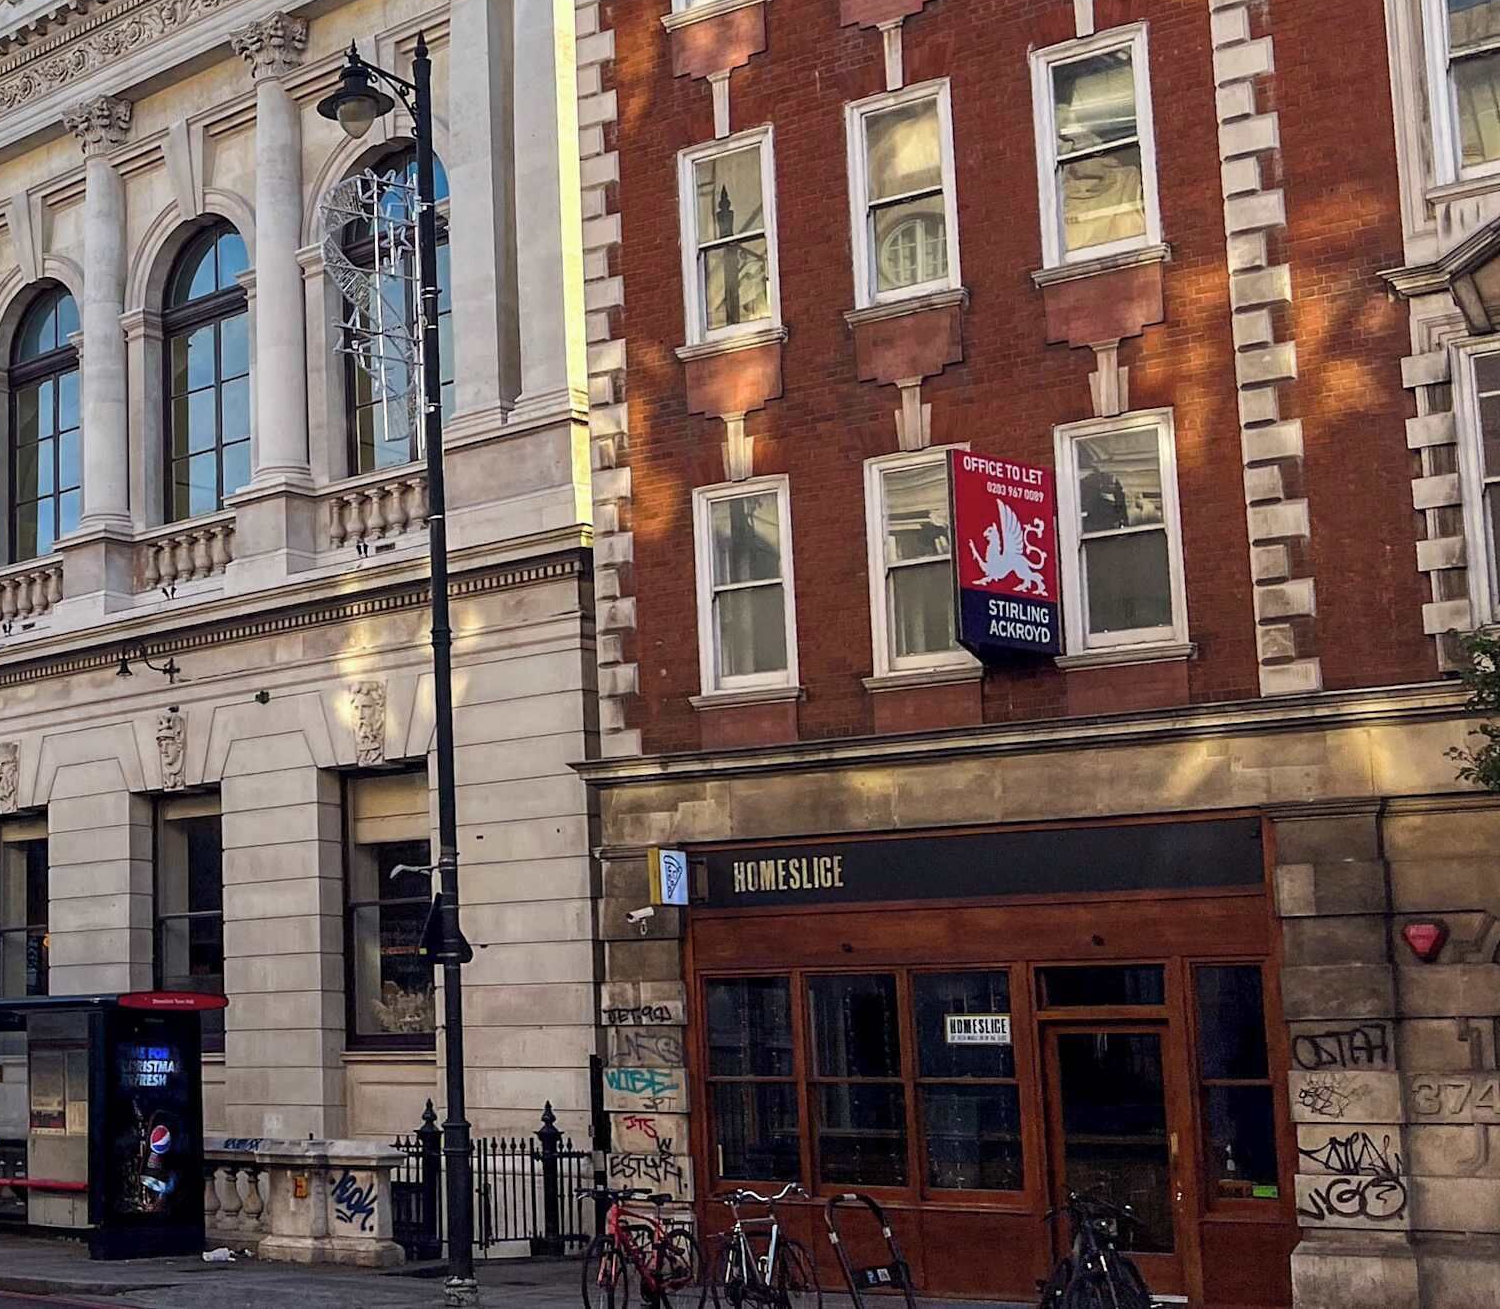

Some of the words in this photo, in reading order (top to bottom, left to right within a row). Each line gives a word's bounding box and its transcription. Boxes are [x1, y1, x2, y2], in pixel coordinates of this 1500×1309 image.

[963, 455, 1003, 478] OFFICE
[1005, 463, 1020, 481] TO
[1022, 468, 1043, 485] LET
[988, 599, 1049, 624] STIRLING
[989, 619, 1051, 643] ACKROYD
[733, 855, 844, 893] HOMESLICE
[950, 1018, 1008, 1034] HOMESLICE
[1411, 1078, 1500, 1116] 374
